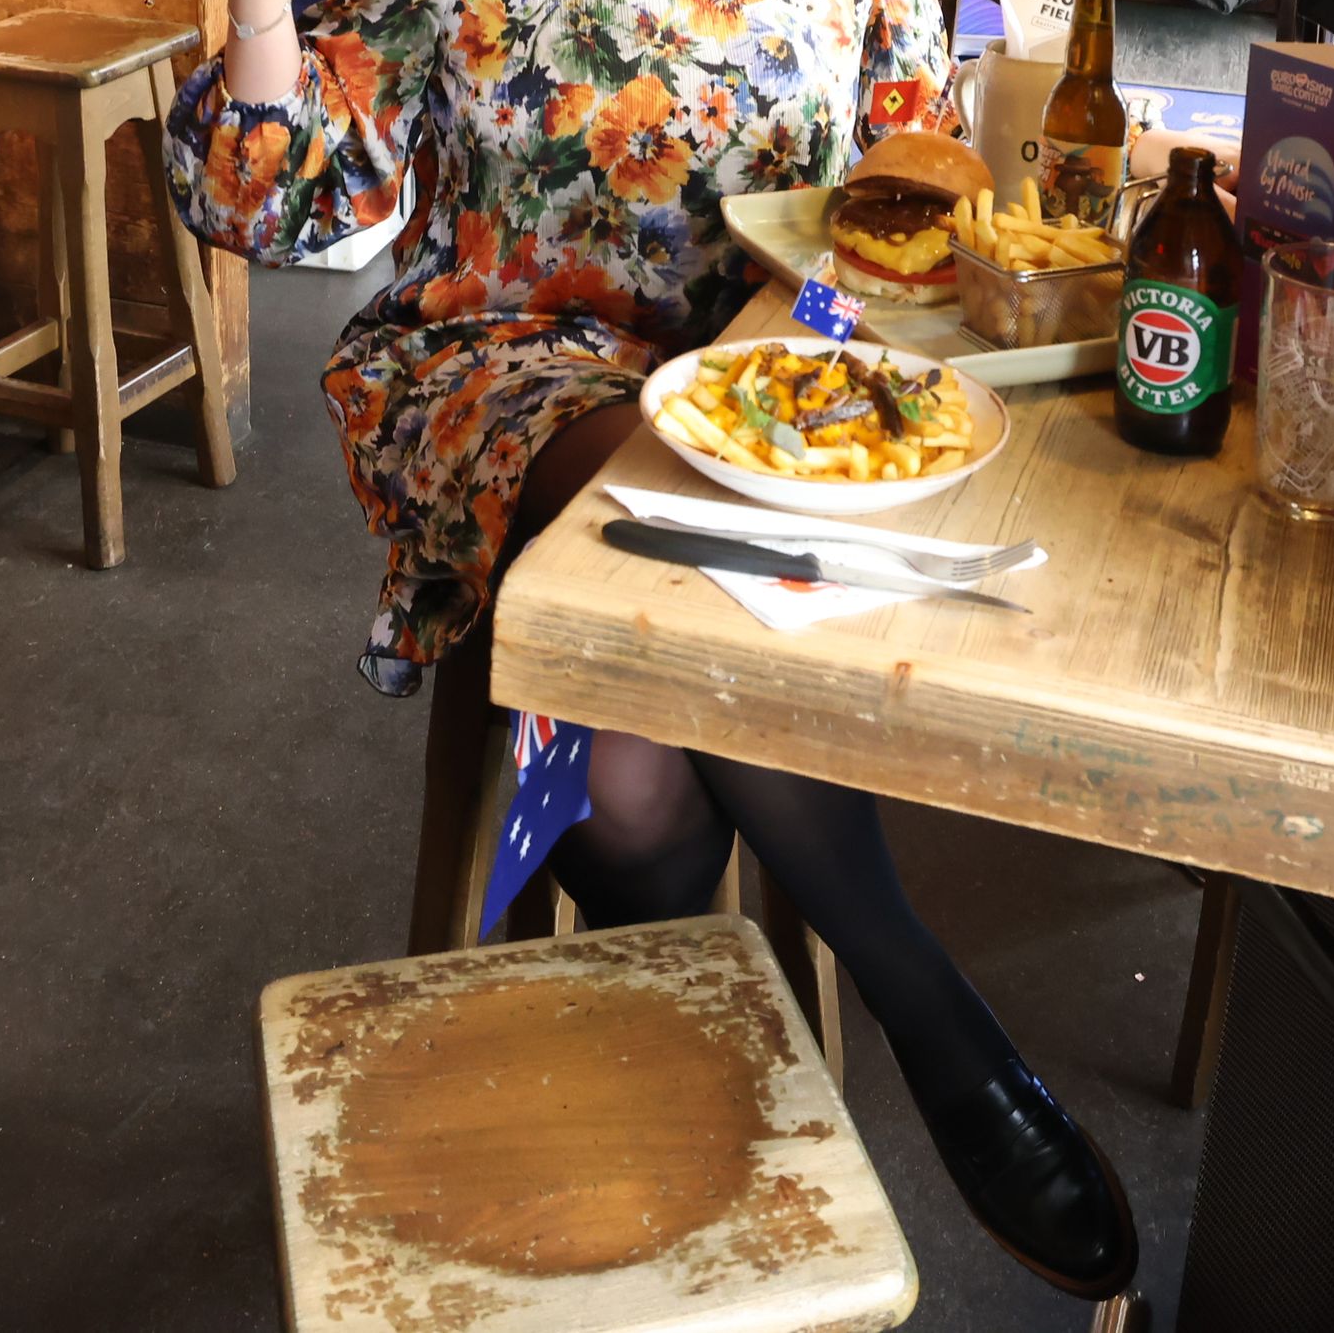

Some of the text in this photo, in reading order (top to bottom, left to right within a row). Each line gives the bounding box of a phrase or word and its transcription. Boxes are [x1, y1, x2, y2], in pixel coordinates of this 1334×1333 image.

[1040, 4, 1072, 22] FIEL
[1292, 87, 1331, 107] CONTEST
[1268, 150, 1311, 181] United
[1260, 172, 1316, 202] by Music
[1124, 287, 1213, 332] VICTORIA
[1132, 323, 1190, 367] VB
[1120, 363, 1202, 406] BITTER
